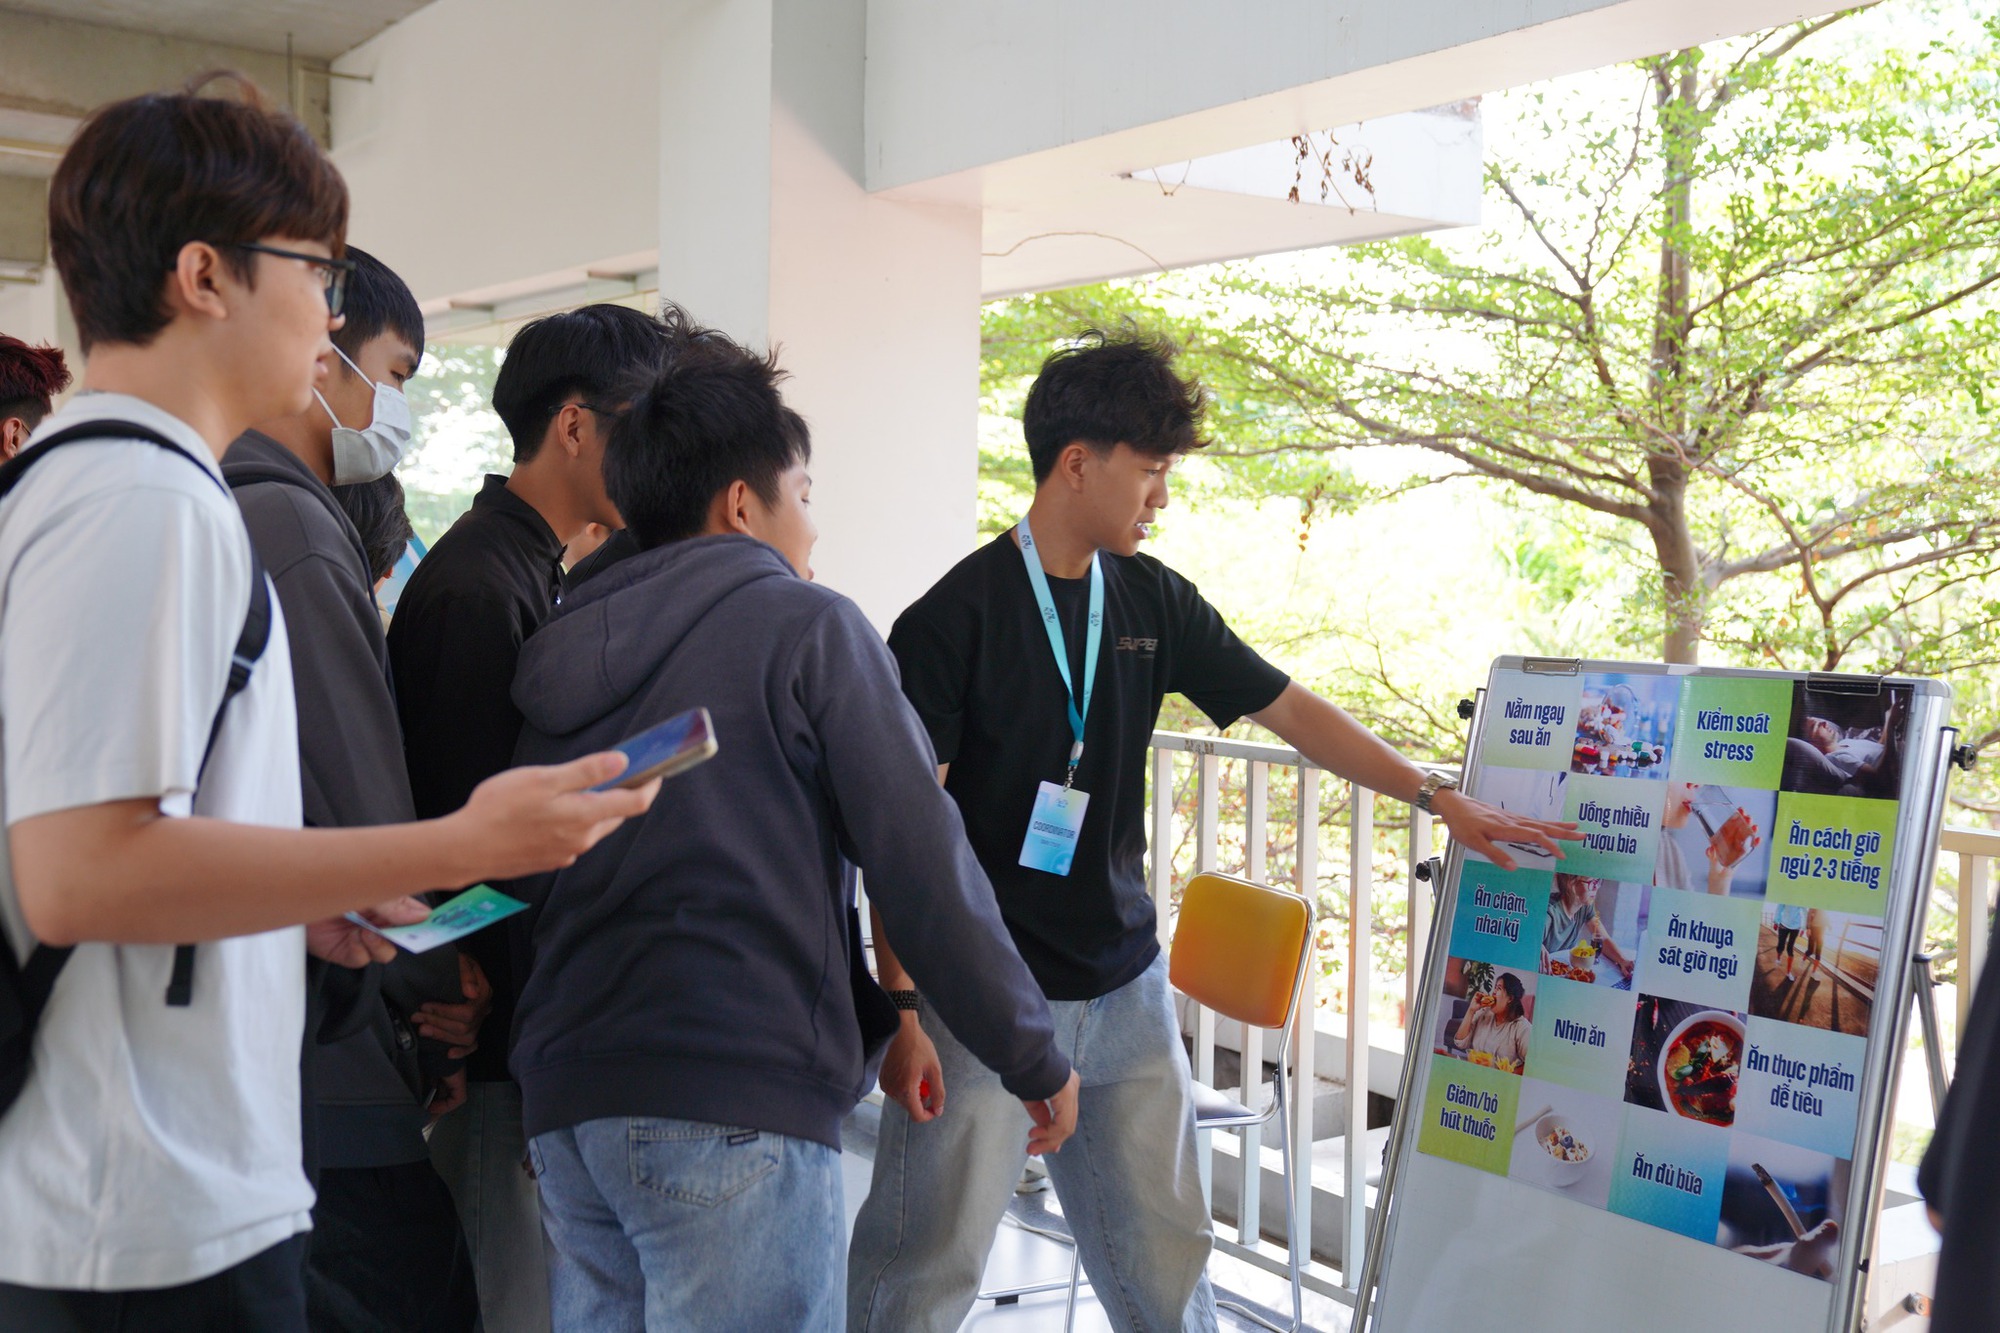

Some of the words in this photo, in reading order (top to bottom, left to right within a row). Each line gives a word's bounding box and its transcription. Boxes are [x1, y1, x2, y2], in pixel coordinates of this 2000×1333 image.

[1504, 697, 1533, 719] Nằm
[1533, 704, 1566, 726] ngay
[1697, 706, 1734, 732] Kiểm
[1736, 713, 1771, 734] soát
[1509, 728, 1534, 745] sau
[1535, 726, 1552, 747] ăn
[1703, 740, 1755, 762] stress
[1578, 800, 1612, 829] Uống
[1612, 804, 1651, 828] nhiều
[1582, 832, 1616, 855] rượu
[1616, 832, 1638, 855] bia
[1789, 819, 1810, 846] Ăn
[1812, 827, 1853, 851] cách
[1853, 831, 1882, 858] giờ
[1779, 853, 1811, 880] ngủ
[1812, 857, 1838, 880] 2-3
[1840, 858, 1882, 890] tiếng
[1474, 884, 1492, 908] Ăn
[1492, 890, 1529, 917] chậm,
[1475, 914, 1503, 936] nhai
[1503, 917, 1520, 943] kỹ
[1668, 912, 1688, 940] Ăn
[1689, 919, 1734, 950] khuya
[1658, 945, 1683, 967] sát
[1682, 949, 1709, 974] giờ
[1708, 954, 1739, 980] ngủ
[1554, 1018, 1588, 1046] Nhịn
[1588, 1024, 1606, 1048] ăn
[1747, 1043, 1770, 1073] Ăn
[1771, 1053, 1807, 1083] thực
[1807, 1062, 1855, 1093] phẩm
[1446, 1083, 1499, 1114] Giảm/bỏ
[1770, 1082, 1791, 1109] dễ
[1791, 1089, 1823, 1117] tiêu
[1440, 1107, 1462, 1131] hút
[1462, 1114, 1496, 1141] thuốc
[1632, 1151, 1654, 1181] Ăn
[1655, 1162, 1675, 1187] đủ
[1676, 1167, 1703, 1196] bữa
